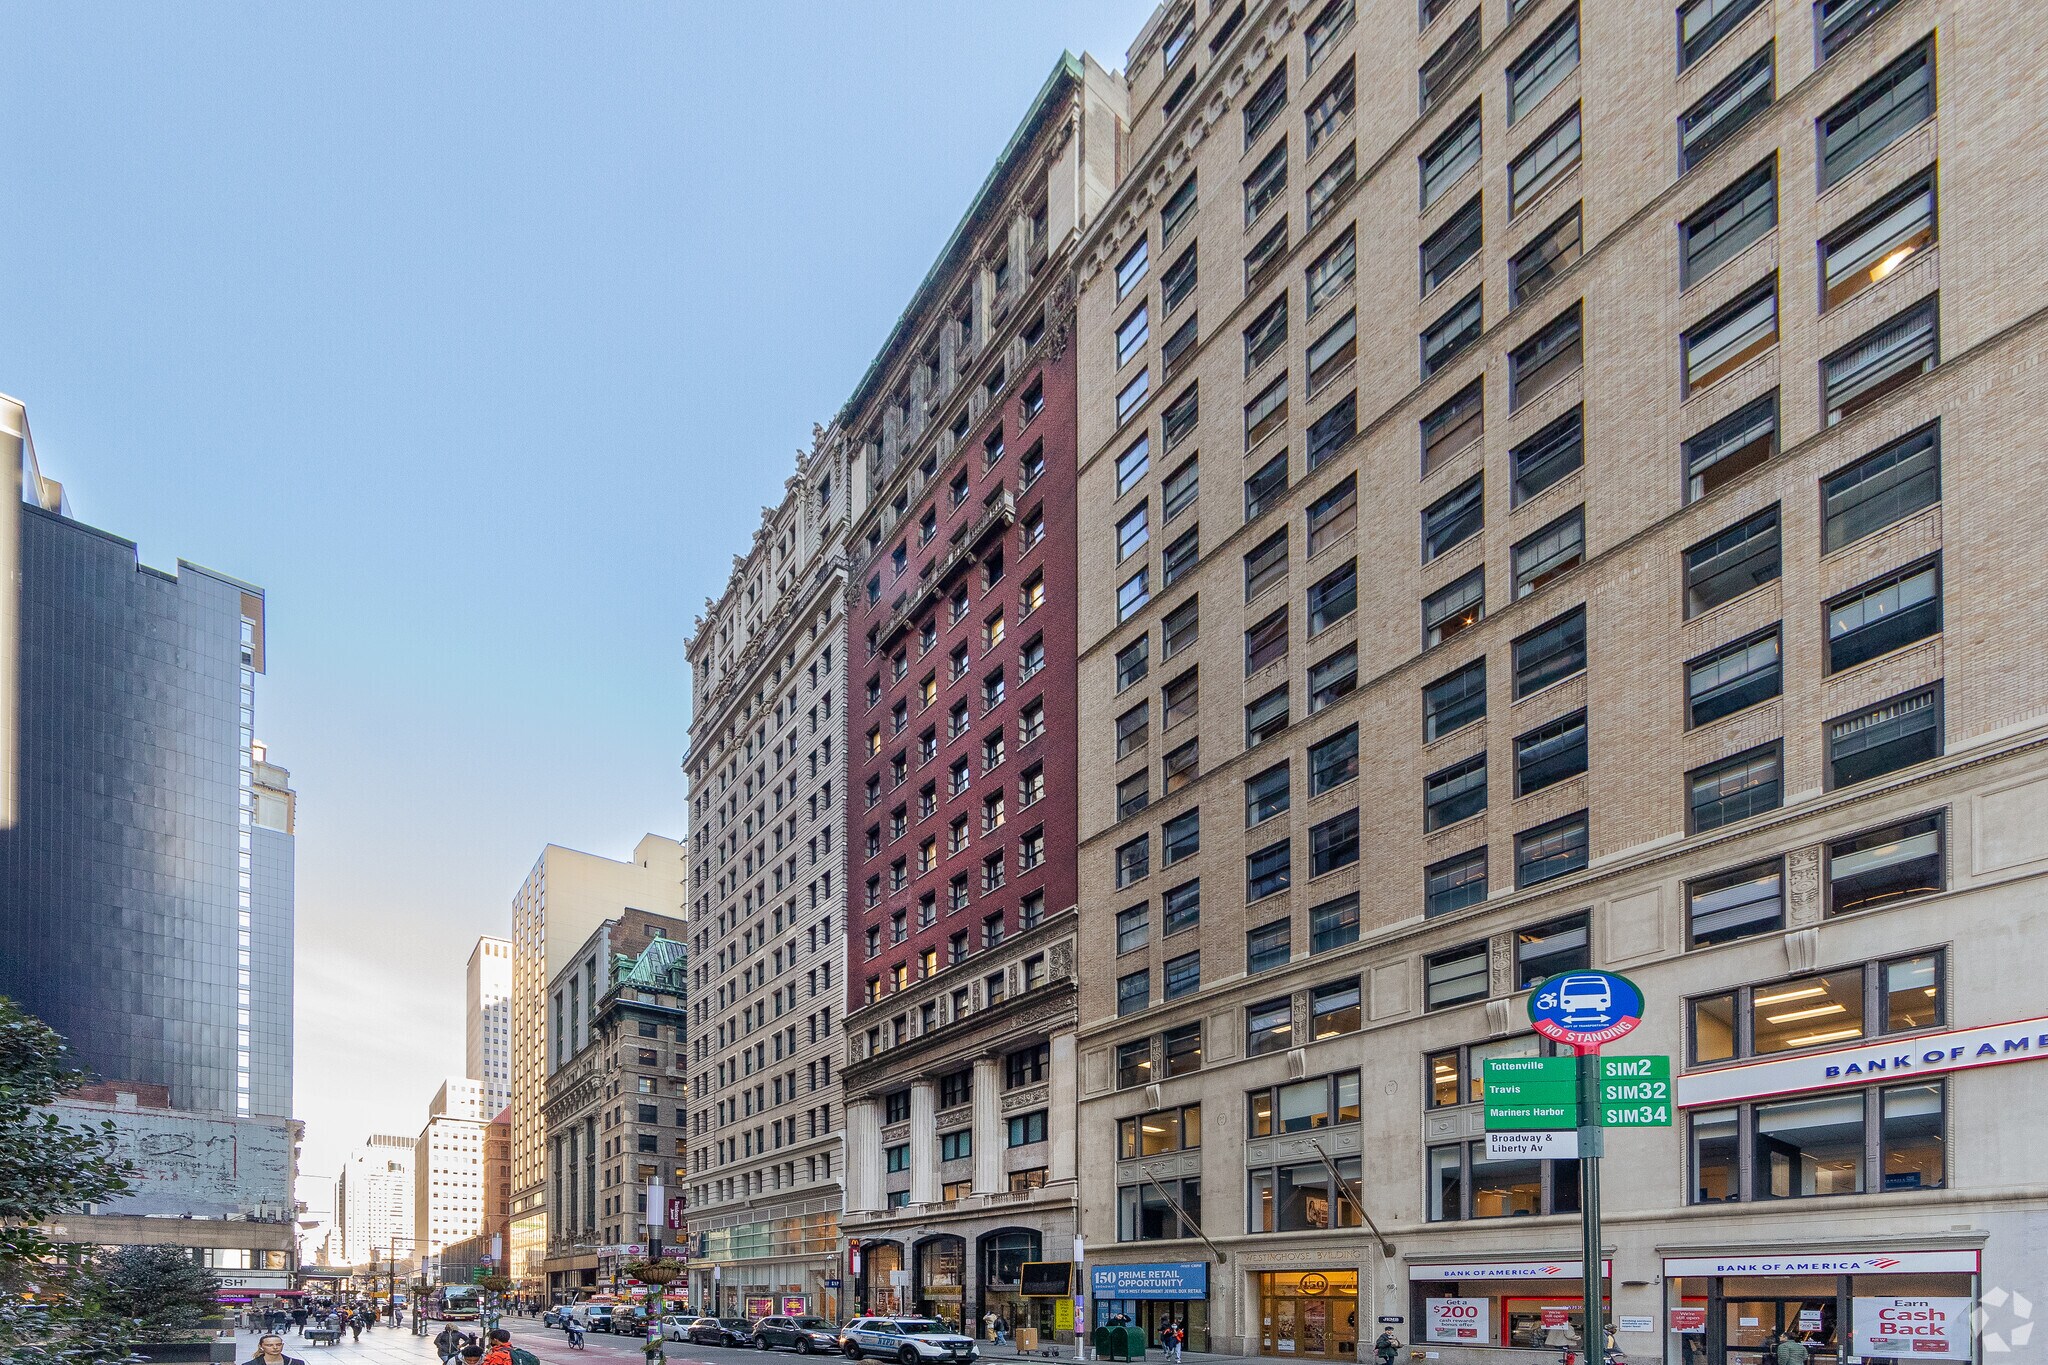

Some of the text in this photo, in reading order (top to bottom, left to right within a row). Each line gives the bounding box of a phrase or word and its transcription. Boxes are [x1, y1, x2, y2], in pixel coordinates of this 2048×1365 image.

[1543, 1021, 1633, 1043] NO STANDING
[1490, 1061, 1544, 1071] Tottenville
[1606, 1059, 1652, 1077] SIM2
[1825, 1054, 1912, 1079] BANK
[1922, 1046, 1966, 1064] OF
[1489, 1085, 1521, 1094] Travis
[1606, 1081, 1667, 1100] SIM32
[1490, 1107, 1565, 1117] Mariners Harbor
[1606, 1106, 1668, 1124] SIM34
[1491, 1133, 1553, 1144] Broadway &
[1491, 1144, 1543, 1154] Liberty Av
[1717, 1262, 1861, 1272] BANK OF AMERICA
[1094, 1271, 1117, 1284] 150
[1118, 1270, 1180, 1279] PRIME RETAIL
[1117, 1278, 1184, 1287] OPPORTUNITY
[1302, 1280, 1325, 1290] 150
[1433, 1305, 1479, 1318] $200
[1878, 1308, 1946, 1321] Cash
[1879, 1322, 1946, 1336] Back
[877, 1338, 895, 1346] NYPD
